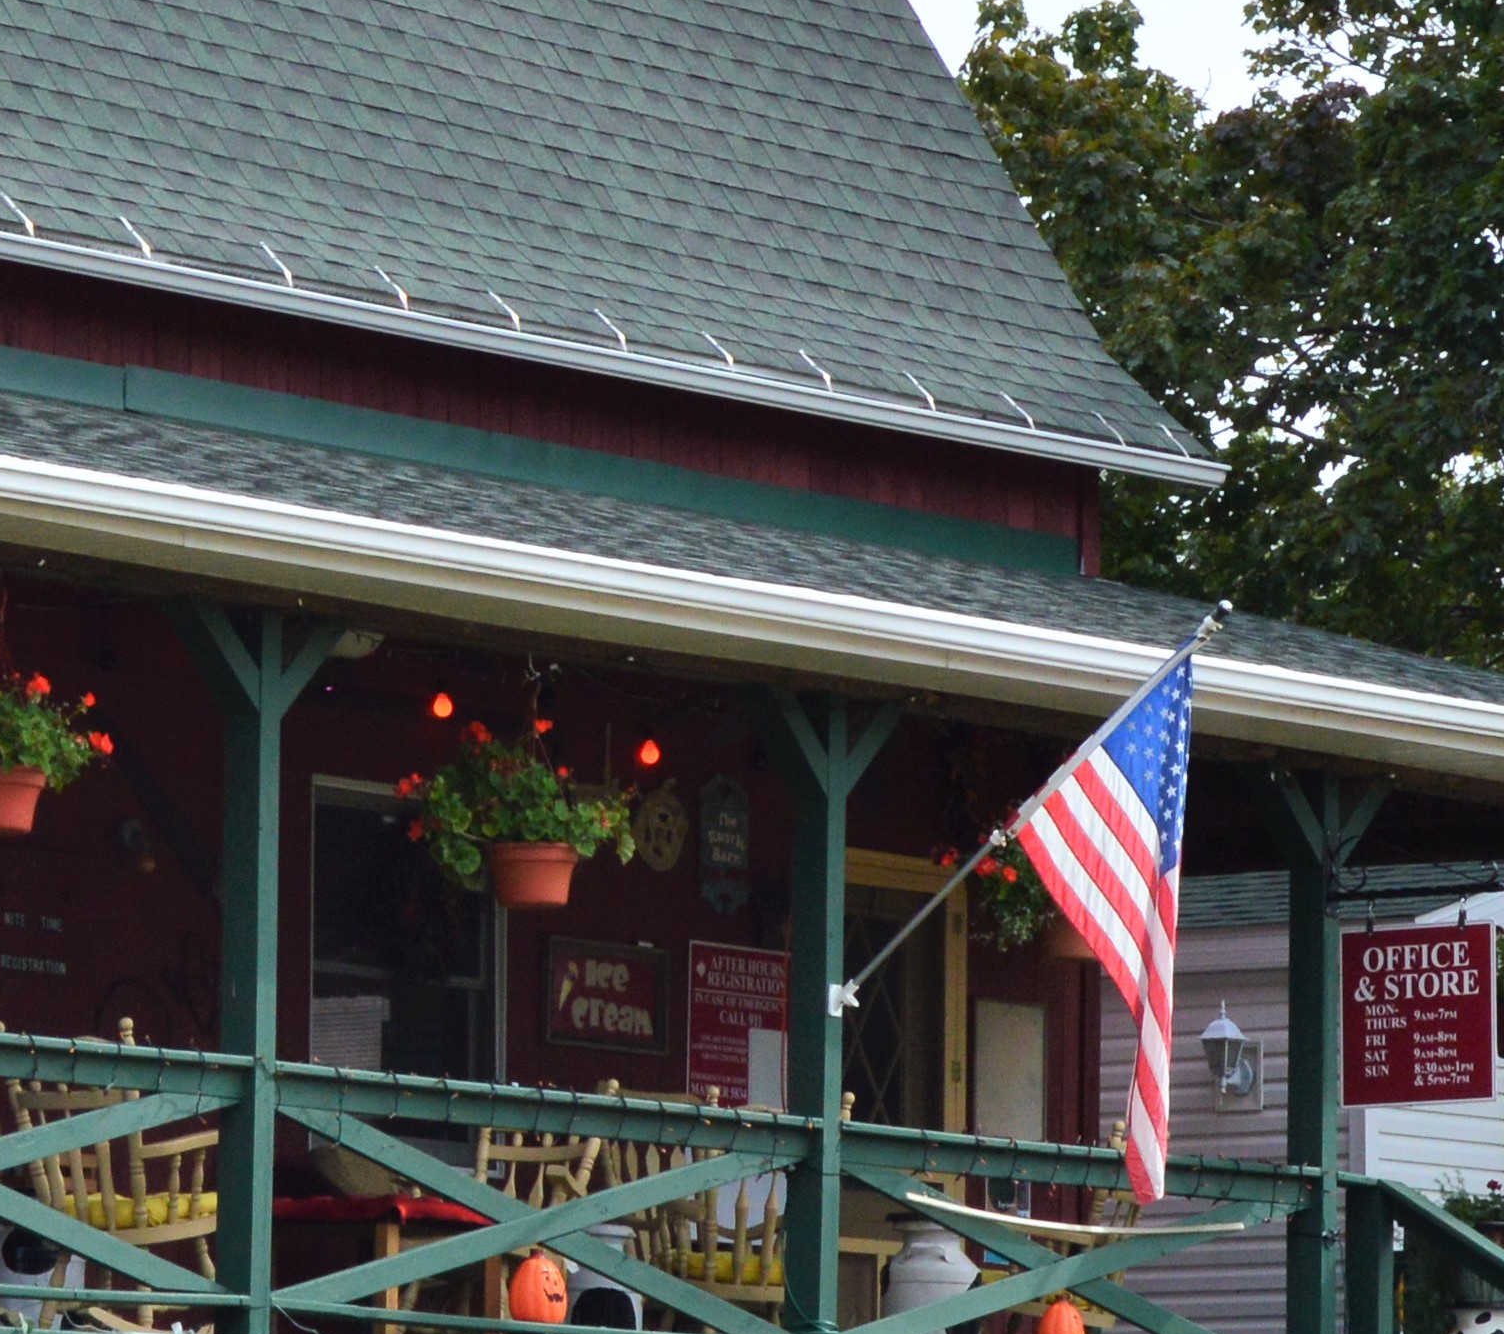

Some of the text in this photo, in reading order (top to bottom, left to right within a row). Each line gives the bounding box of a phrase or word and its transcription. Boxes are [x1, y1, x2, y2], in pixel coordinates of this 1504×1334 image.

[3, 912, 63, 932] NITE TIME
[1363, 941, 1470, 972] OFFICE
[0, 954, 66, 976] REGISTRATION
[711, 956, 785, 977] AFTER HOURS
[1354, 969, 1480, 1002] & STORE
[704, 993, 724, 1006] CASE
[1365, 1004, 1399, 1016] MON-
[1414, 1008, 1457, 1020] 9AM-7PM
[719, 1010, 762, 1028] CALL 911
[1365, 1016, 1407, 1030] THURS
[1365, 1031, 1457, 1046] FRI 9AM-8PM
[1365, 1047, 1457, 1062] SAT 9AM-8PM
[1365, 1061, 1474, 1077] SUN 8:30AM-1PM
[1414, 1075, 1424, 1086] &
